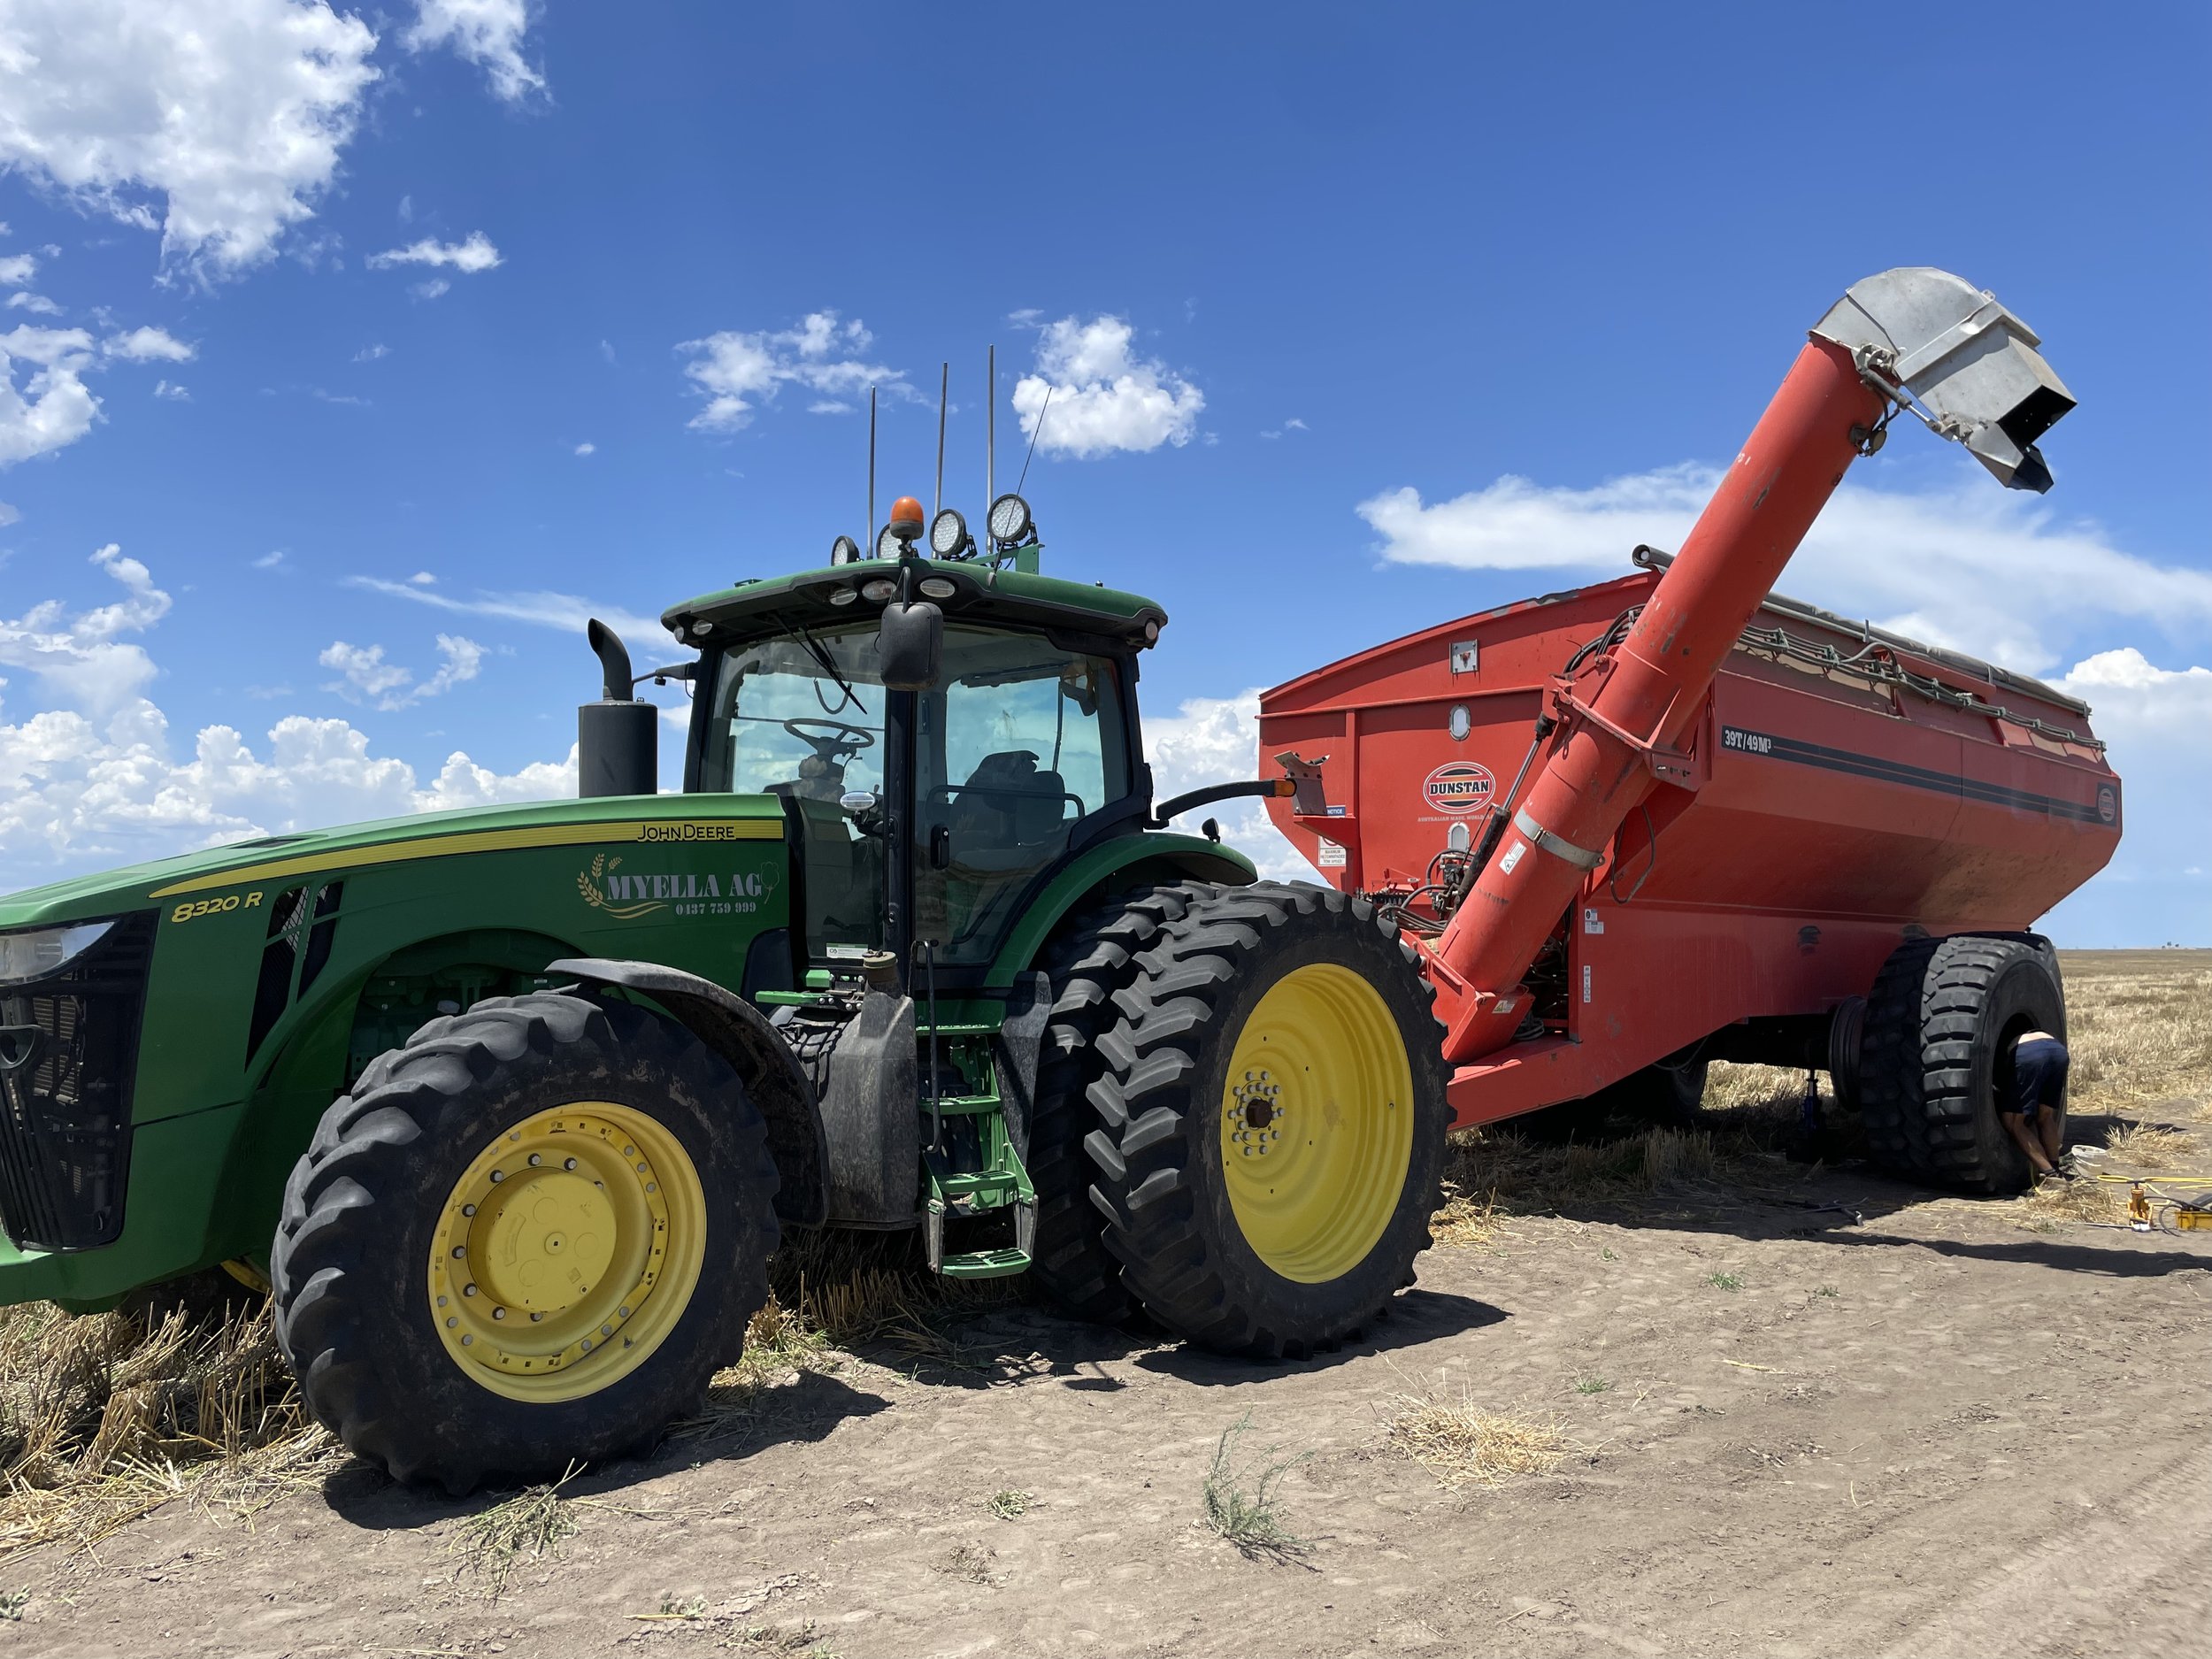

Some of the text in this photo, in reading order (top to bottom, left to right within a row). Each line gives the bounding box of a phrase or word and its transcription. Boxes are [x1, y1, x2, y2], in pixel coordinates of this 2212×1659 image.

[1429, 780, 1489, 795] DUNSTAN
[606, 873, 763, 901] MYELLA AG
[172, 891, 264, 923] 8320 R
[710, 902, 732, 915] 759
[734, 902, 757, 914] 999
